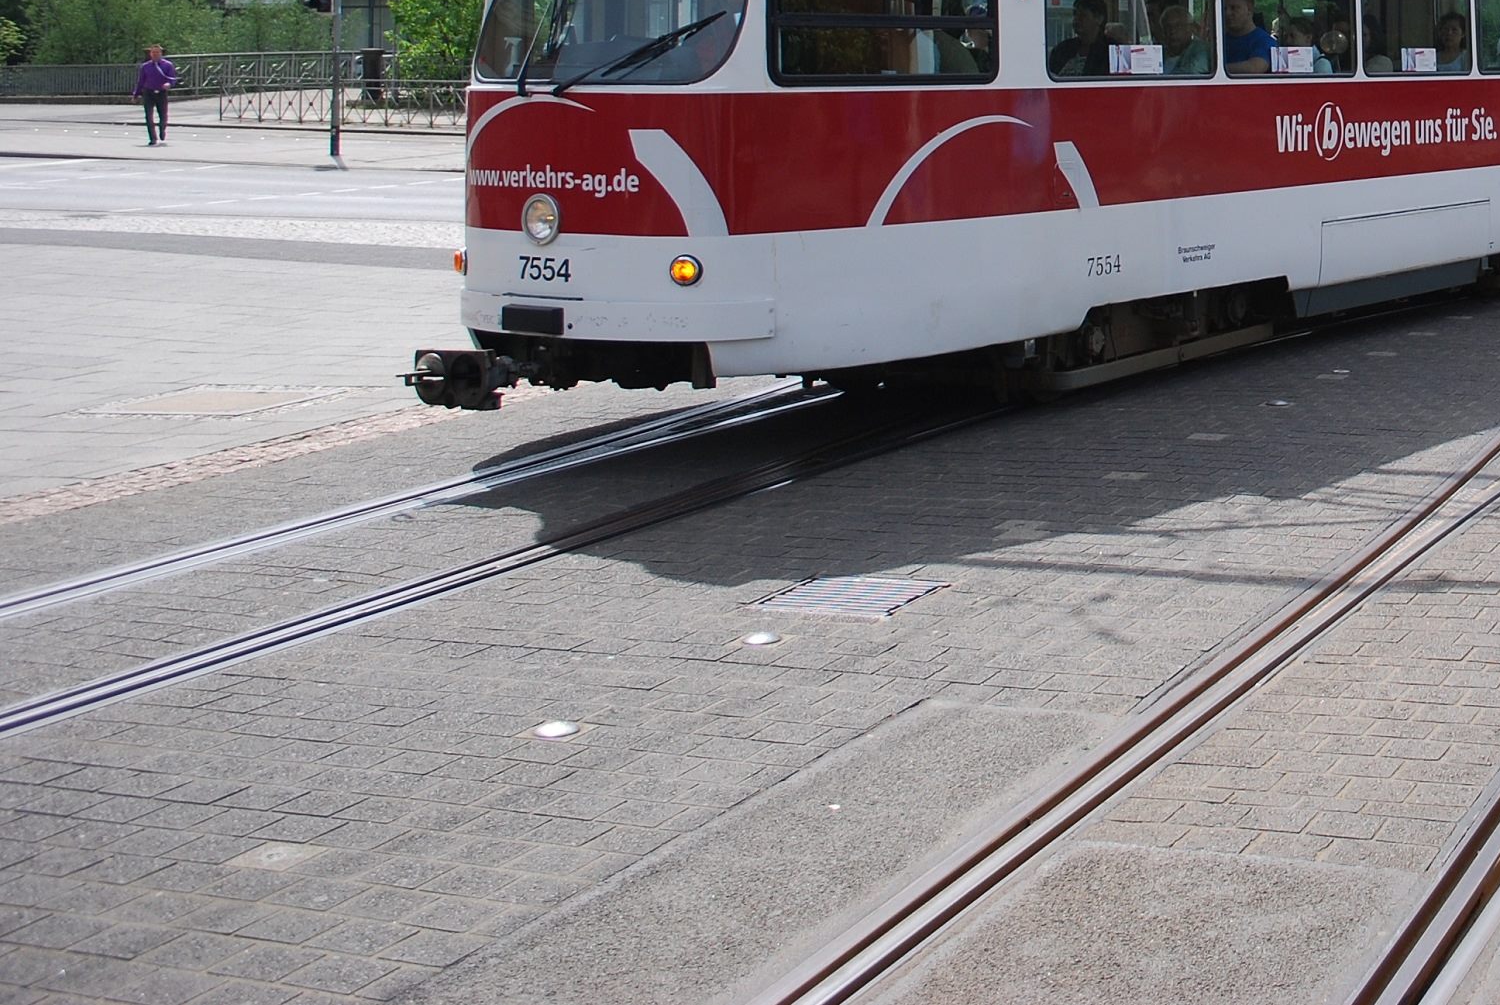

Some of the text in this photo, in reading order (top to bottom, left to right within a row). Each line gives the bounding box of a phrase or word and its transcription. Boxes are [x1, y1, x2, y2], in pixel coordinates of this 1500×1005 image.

[1276, 113, 1312, 153] Wir
[1415, 117, 1442, 144] uns
[1445, 107, 1469, 142] für
[1471, 107, 1498, 141] Sie.
[469, 164, 640, 197] www.verkehrs-ag.de
[519, 255, 571, 282] 7554
[1087, 254, 1121, 277] 7554
